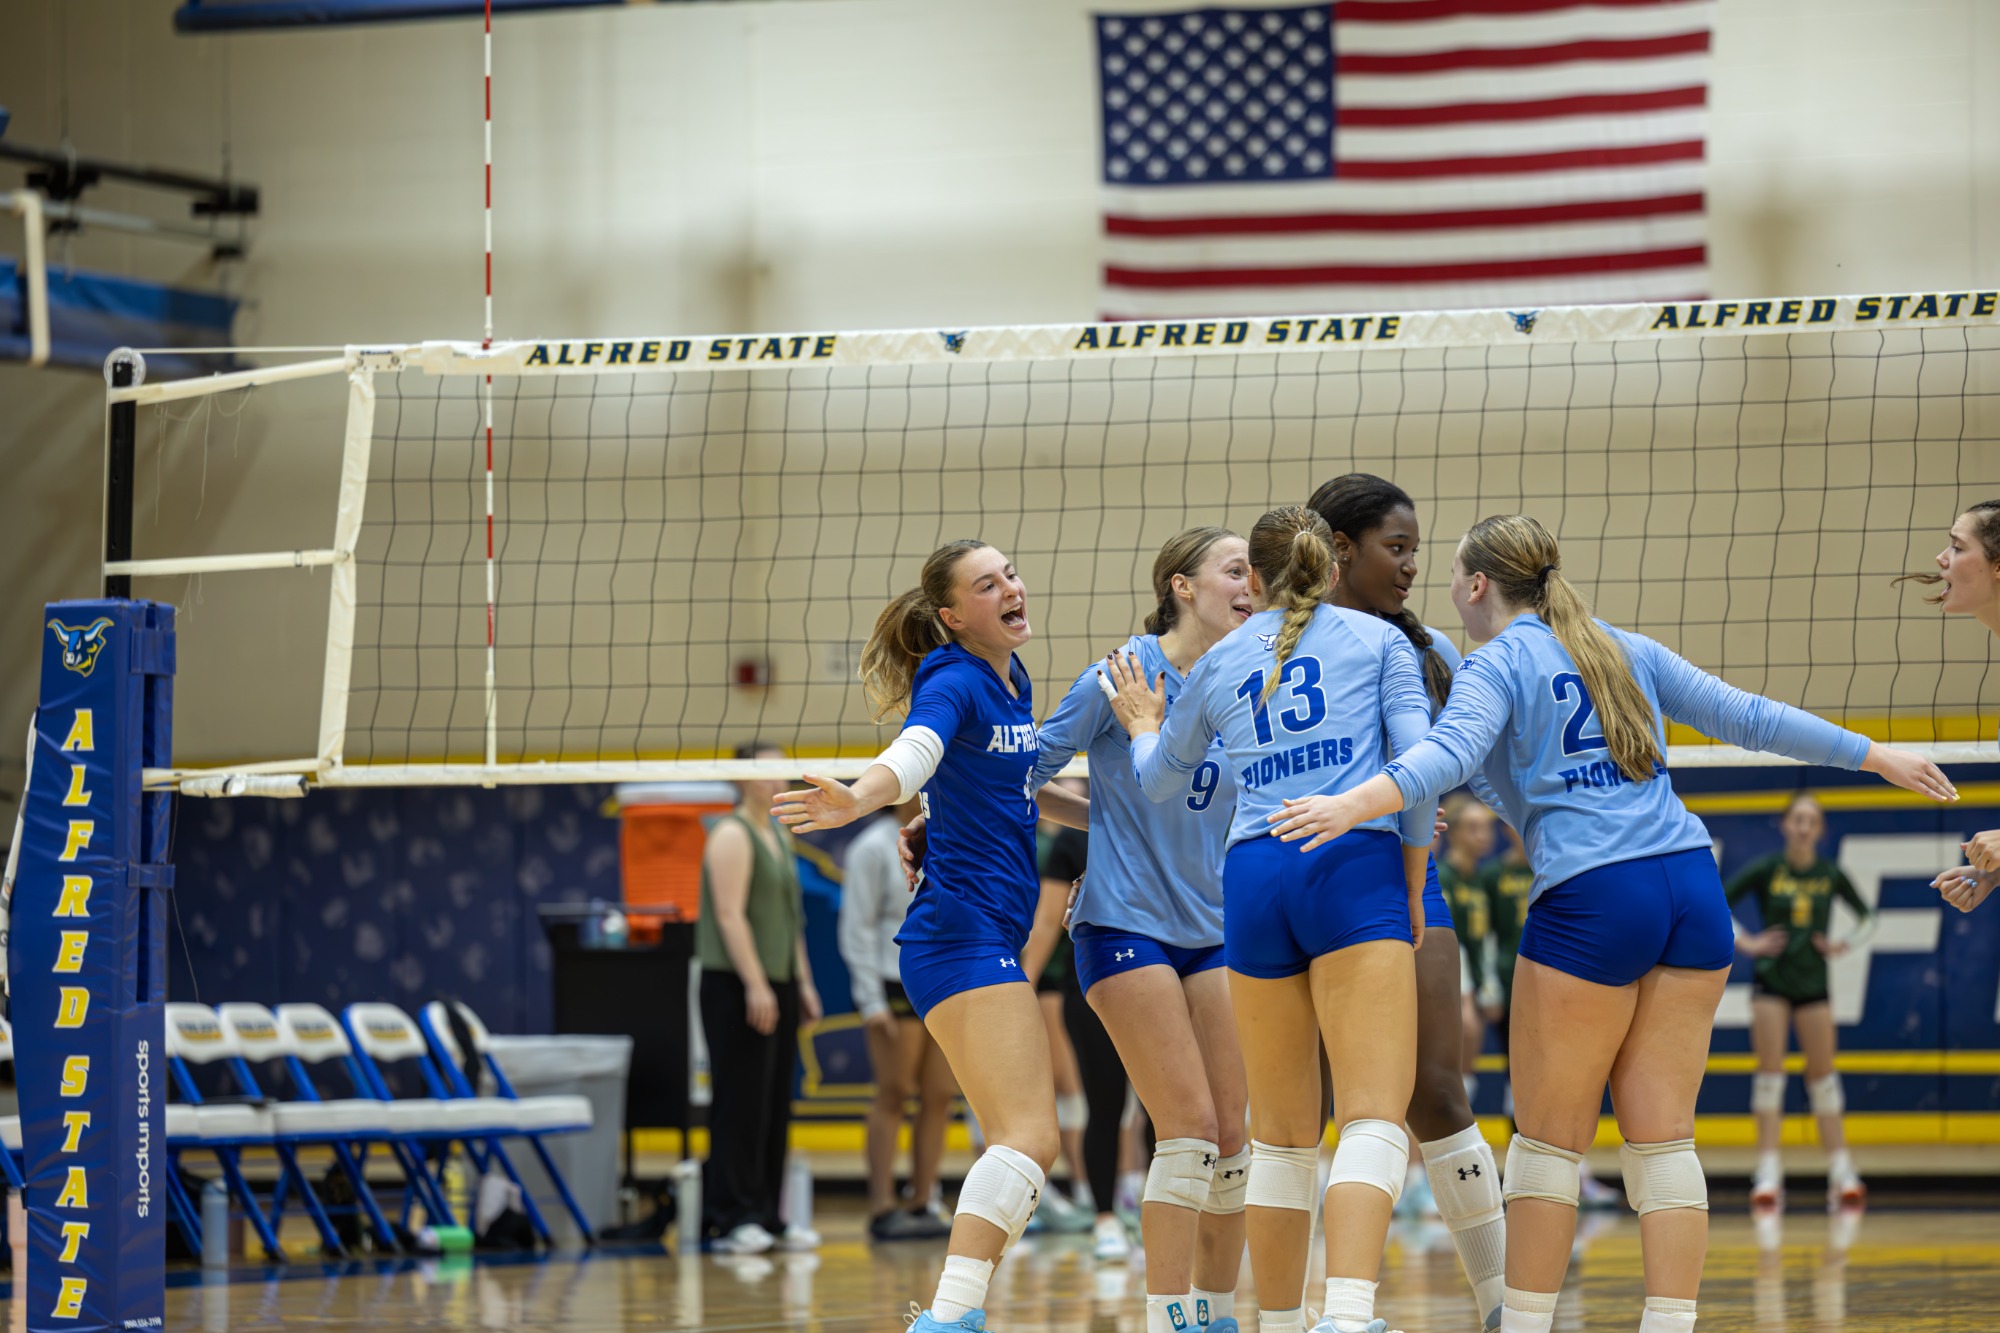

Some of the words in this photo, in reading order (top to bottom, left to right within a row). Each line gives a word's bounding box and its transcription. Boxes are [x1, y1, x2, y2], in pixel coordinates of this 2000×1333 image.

[1074, 320, 1250, 350] ALFRED
[1265, 315, 1401, 343] STATE
[1651, 299, 1838, 330] ALFRED
[1854, 291, 1998, 322] STATE
[526, 339, 692, 366] ALFRED
[707, 335, 837, 361] STATE
[1235, 654, 1328, 748] 13
[1186, 759, 1222, 813] 9
[1241, 737, 1353, 794] PIONEERS
[1557, 760, 1667, 794] PION
[53, 707, 95, 1029] ALFRED
[136, 1039, 151, 1119] sports
[51, 1055, 91, 1319] STATE
[136, 1121, 151, 1218] imports
